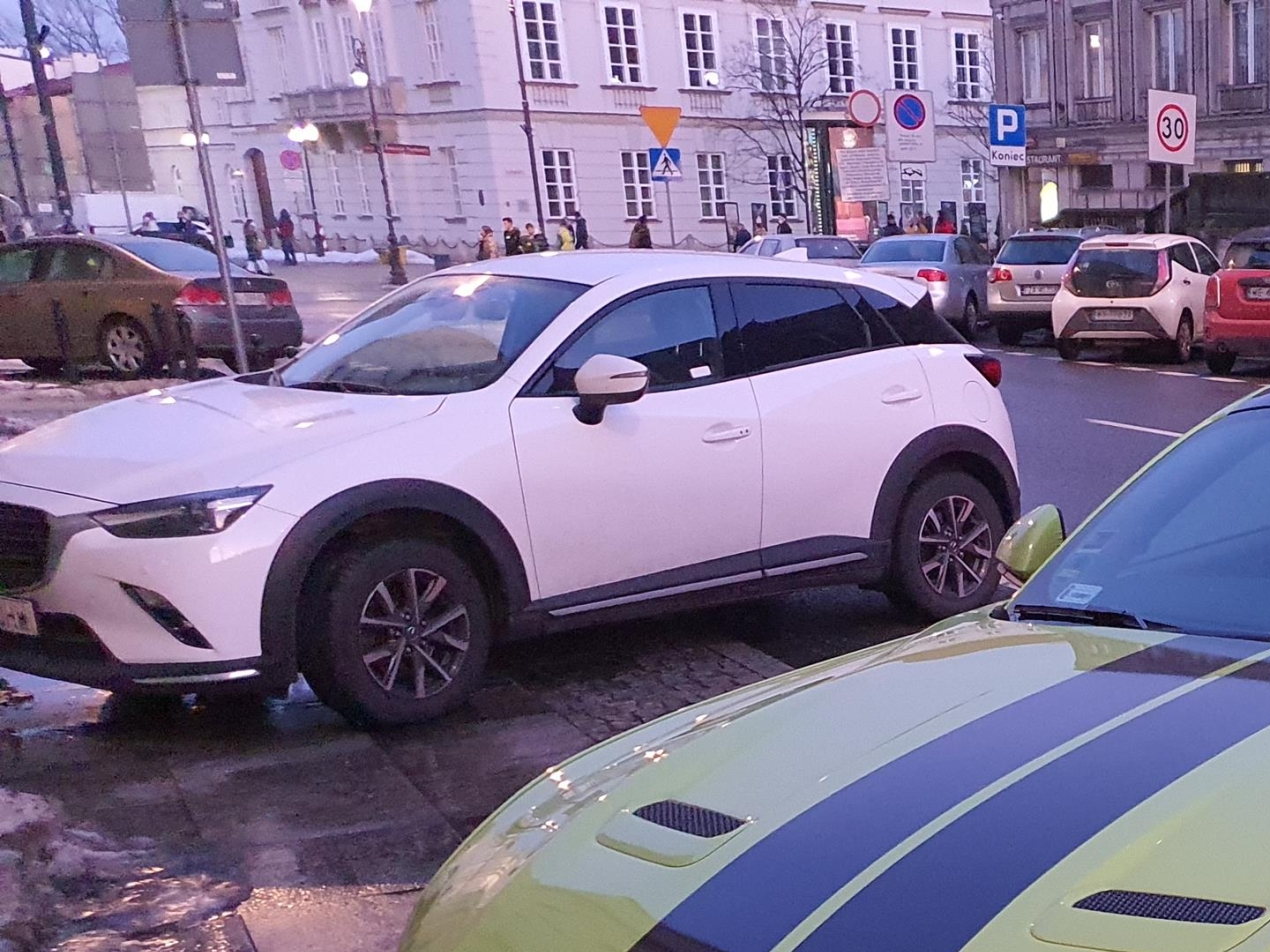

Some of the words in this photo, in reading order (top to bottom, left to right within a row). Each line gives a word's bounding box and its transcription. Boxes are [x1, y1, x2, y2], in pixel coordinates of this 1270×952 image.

[997, 108, 1019, 141] P
[1162, 116, 1185, 140] 30
[991, 150, 1025, 161] Koniec
[1025, 154, 1062, 164] STAURANT
